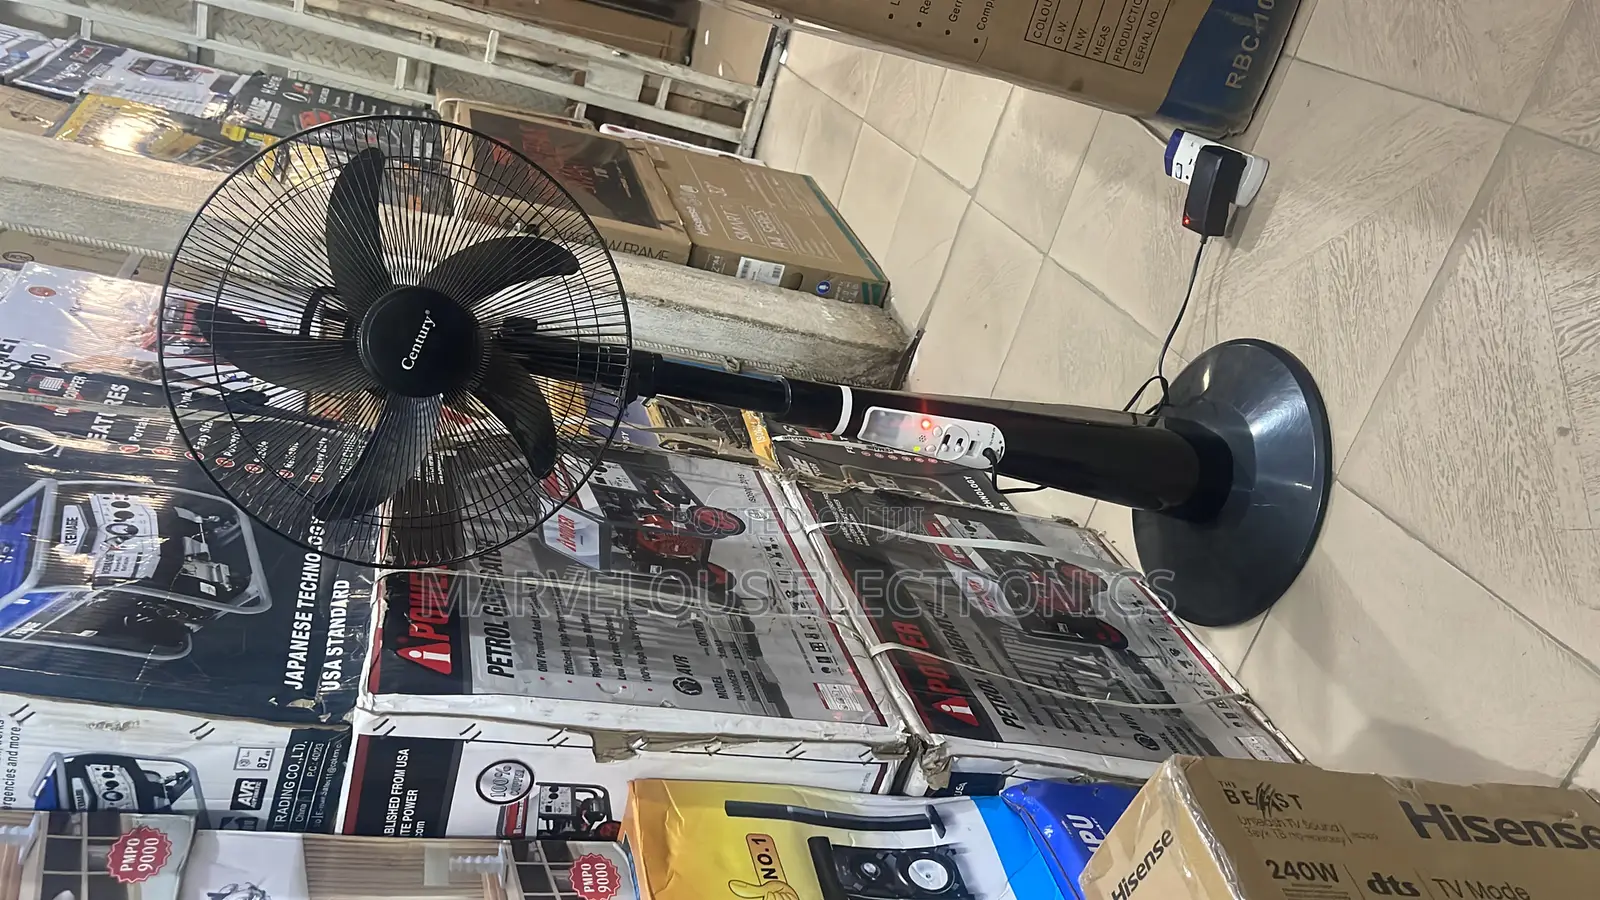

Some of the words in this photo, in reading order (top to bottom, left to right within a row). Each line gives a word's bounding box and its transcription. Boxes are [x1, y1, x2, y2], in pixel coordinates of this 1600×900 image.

[975, 0, 996, 31] Comp
[1093, 25, 1111, 57] MEAS
[1132, 27, 1153, 68] SERIAL
[401, 315, 436, 371] Century
[296, 515, 326, 609] TECHNOOGY
[325, 579, 351, 657] STANDARD
[283, 611, 314, 690] JAPANESE
[483, 620, 515, 679] PETROL
[672, 654, 694, 676] AVR
[319, 658, 344, 692] USA
[711, 675, 730, 700] MODEL
[973, 677, 1027, 731] PETROL
[9, 726, 22, 749] more
[1119, 712, 1145, 733] AVR
[6, 750, 19, 769] and
[256, 757, 270, 769] 87
[398, 748, 411, 768] USA
[238, 780, 257, 808] AVR
[391, 769, 406, 796] FROM
[489, 764, 513, 798] 100%
[273, 781, 296, 829] TRADING
[403, 789, 419, 823] POWER
[1222, 782, 1304, 820] BEAST
[1397, 799, 1600, 850] Hisense
[120, 837, 141, 872] PMPO
[136, 837, 160, 872] 9000
[750, 836, 780, 881] NO.1
[1110, 829, 1175, 900] Hisense
[1265, 858, 1340, 884] 240W
[583, 862, 593, 894] PMPO
[596, 861, 609, 894] 9000
[1366, 871, 1421, 898] dts
[1431, 877, 1465, 900] TV
[1465, 877, 1531, 900] Mode
